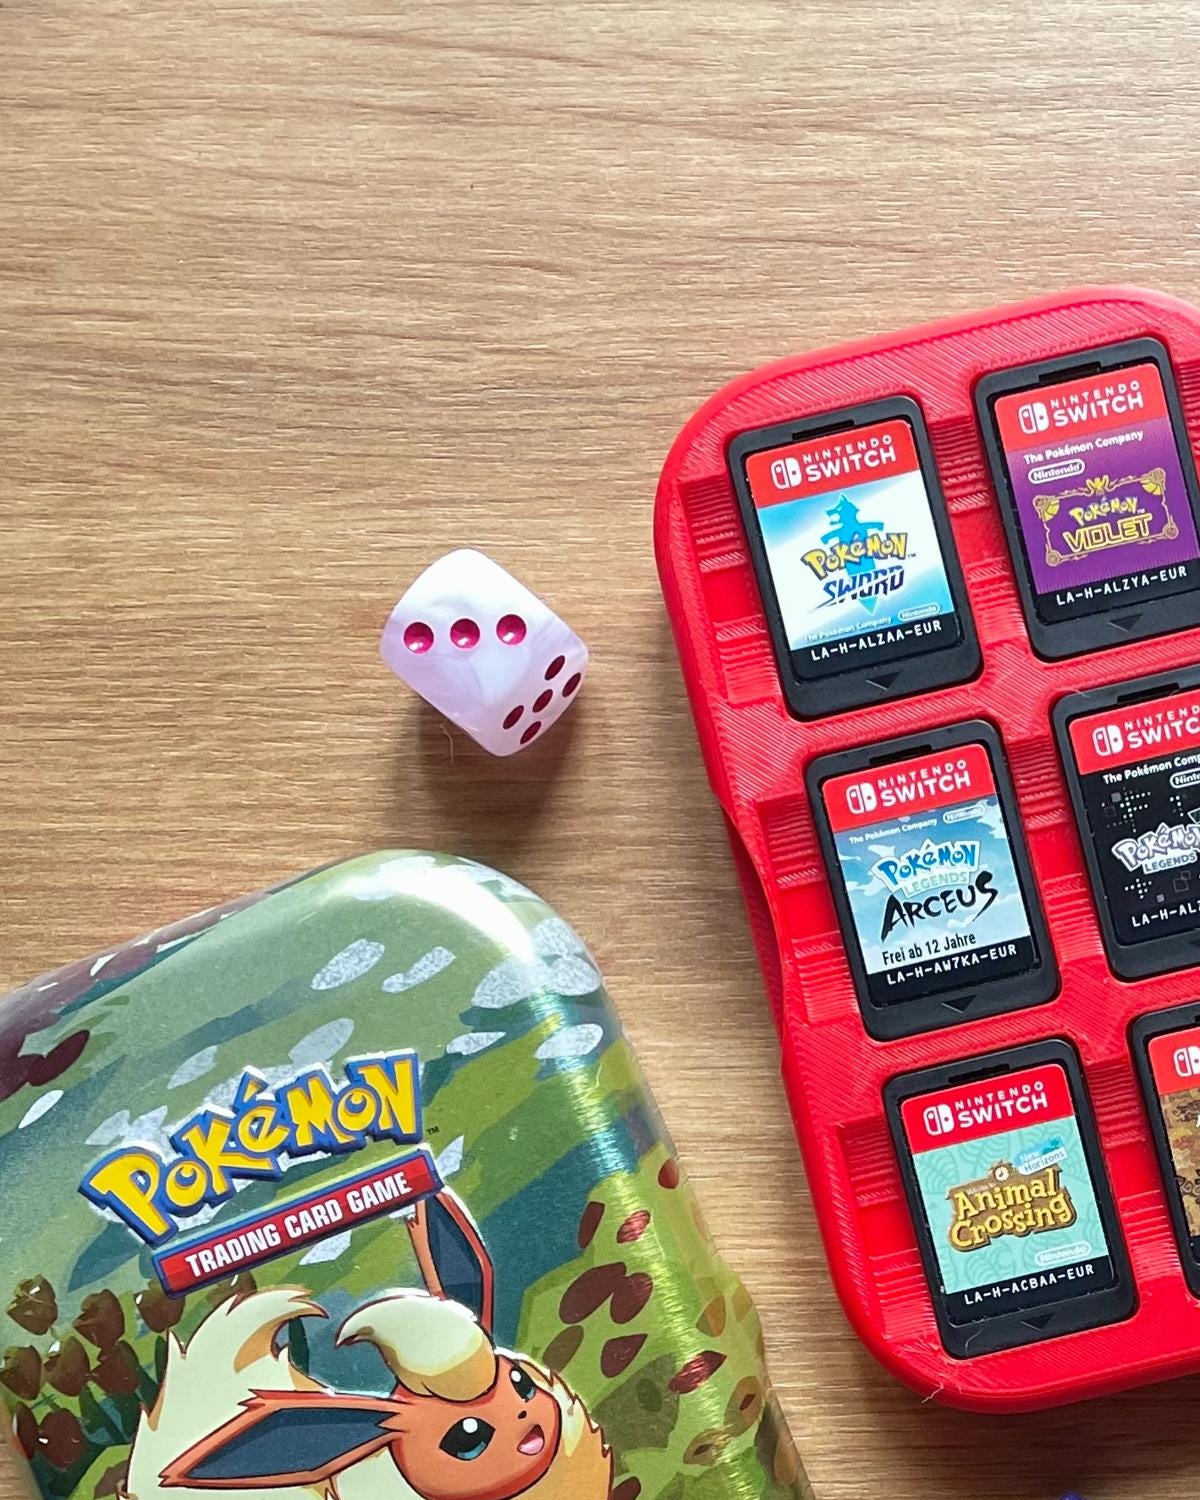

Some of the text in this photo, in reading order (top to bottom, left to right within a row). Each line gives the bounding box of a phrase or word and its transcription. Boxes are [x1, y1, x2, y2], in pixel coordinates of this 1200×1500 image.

[1050, 381, 1140, 408] NINTENDO
[1054, 392, 1143, 427] SWITCH
[803, 435, 893, 464] NINTENDO
[805, 446, 897, 482] SWITCH
[1024, 430, 1144, 464] The Pokémon Company
[1063, 513, 1152, 552] VIOLET
[815, 565, 905, 608] SWORD
[1056, 566, 1187, 606] LA-H-ALZYA-EUR
[811, 620, 942, 660] LA-H-ALZAA-EUR
[877, 760, 966, 789] NINTENDO
[880, 770, 971, 807] SWITCH
[1103, 772, 1122, 784] The
[1125, 761, 1172, 780] Pokémon
[902, 818, 938, 833] Company
[1144, 853, 1197, 871] LEGENDS
[904, 872, 968, 894] LEGENDS
[881, 871, 998, 943] ARCEUS
[883, 932, 976, 965] Frei ab 12 Jahre
[887, 944, 1017, 985] LA-H-AW7KA-EUR
[956, 1081, 1044, 1110] NINTENDO
[959, 1094, 1048, 1128] SWITCH
[1024, 1150, 1065, 1173] Horizons
[954, 1168, 1059, 1220] Animal
[185, 1171, 412, 1279] TRADING CARD GAME
[951, 1193, 1073, 1248] Crossing
[964, 1264, 1094, 1305] LA-H-ACBAA-EUR
